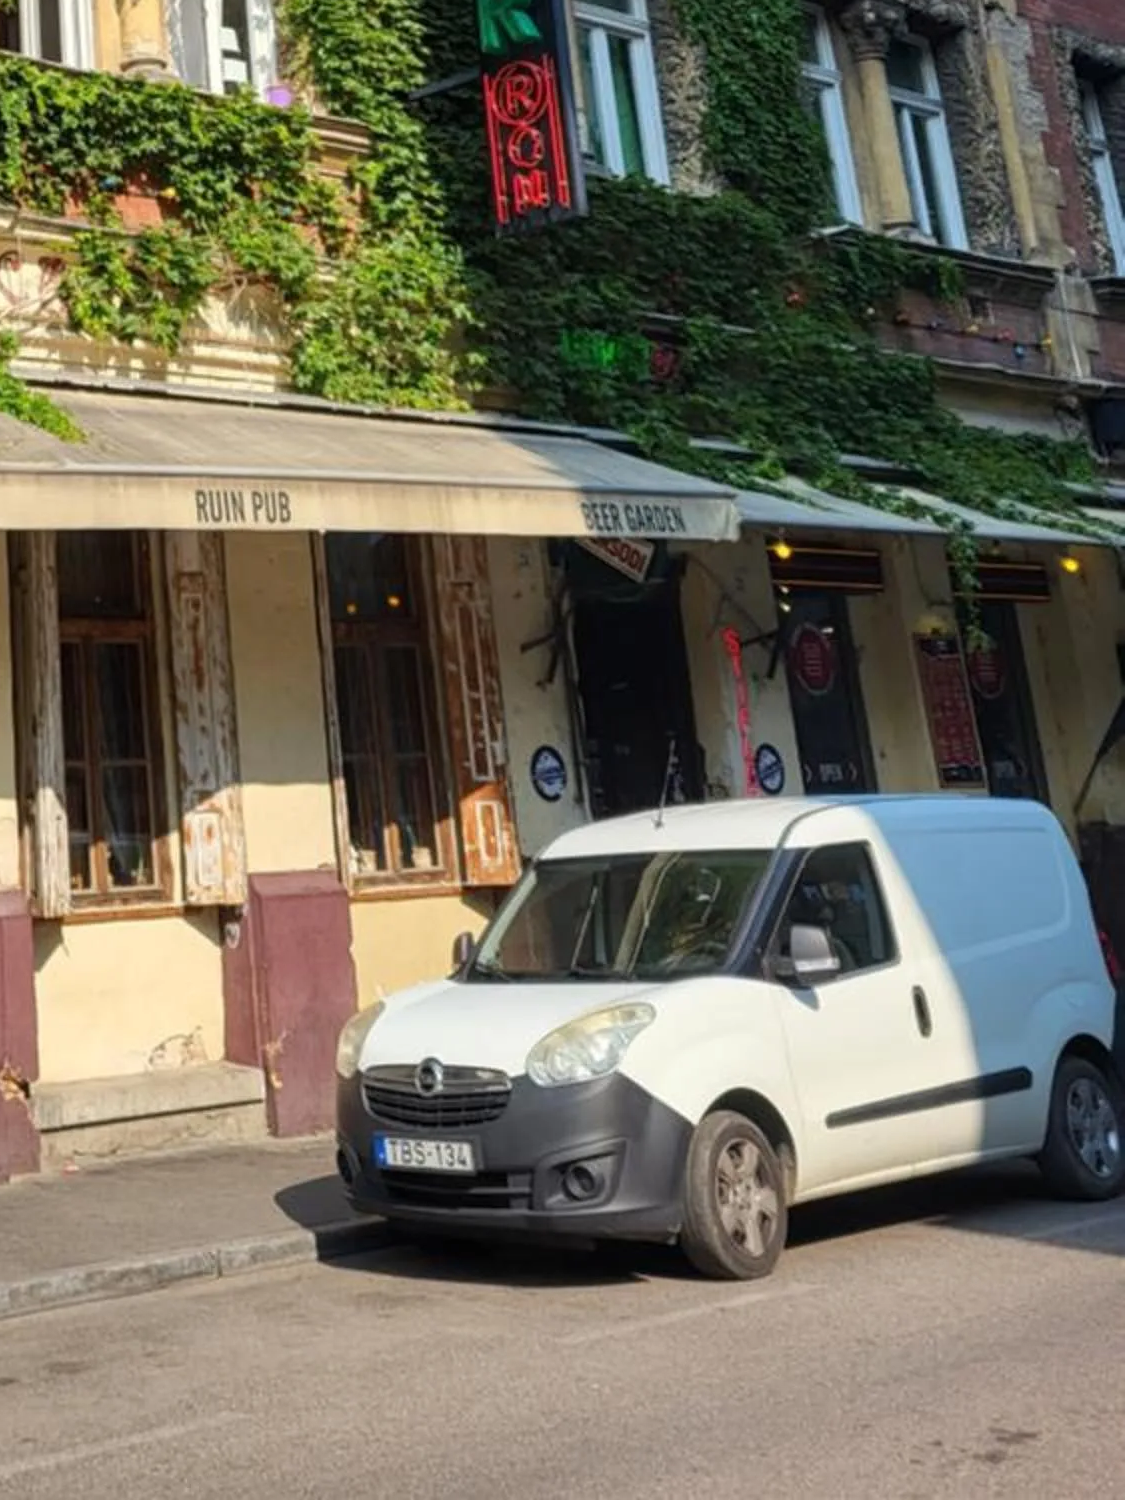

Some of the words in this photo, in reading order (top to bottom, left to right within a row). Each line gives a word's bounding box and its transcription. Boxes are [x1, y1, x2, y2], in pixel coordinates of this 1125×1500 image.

[195, 489, 246, 524] RUIN
[251, 490, 292, 524] PUB
[581, 501, 624, 533] BEER
[624, 503, 686, 533] GARDEN
[389, 1139, 468, 1167] TBS-134
